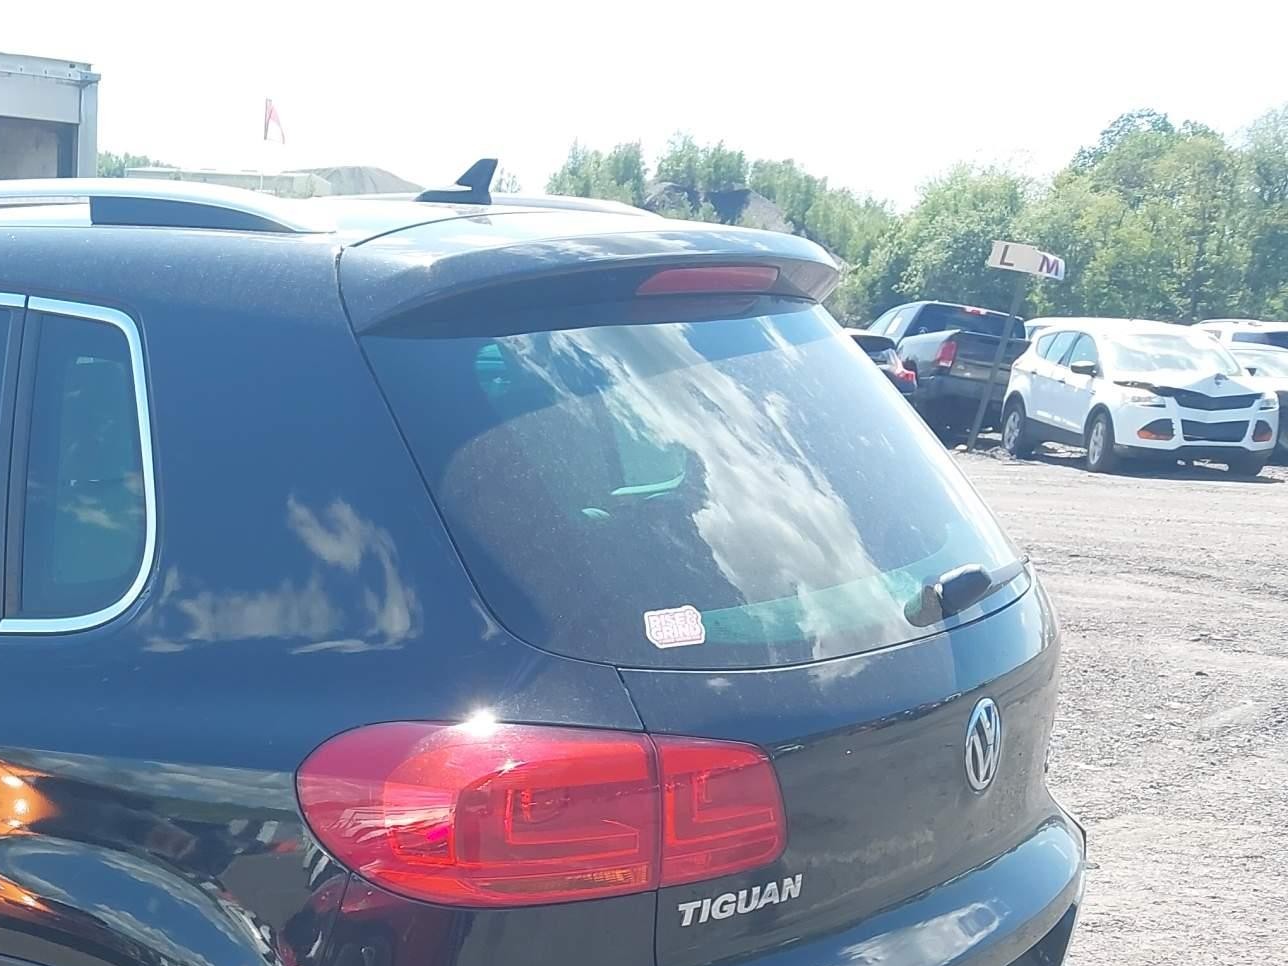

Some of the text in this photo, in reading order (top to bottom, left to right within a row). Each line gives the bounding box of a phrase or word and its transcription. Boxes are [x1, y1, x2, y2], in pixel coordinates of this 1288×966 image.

[999, 244, 1059, 276] L M
[678, 873, 803, 927] TIGUAN
